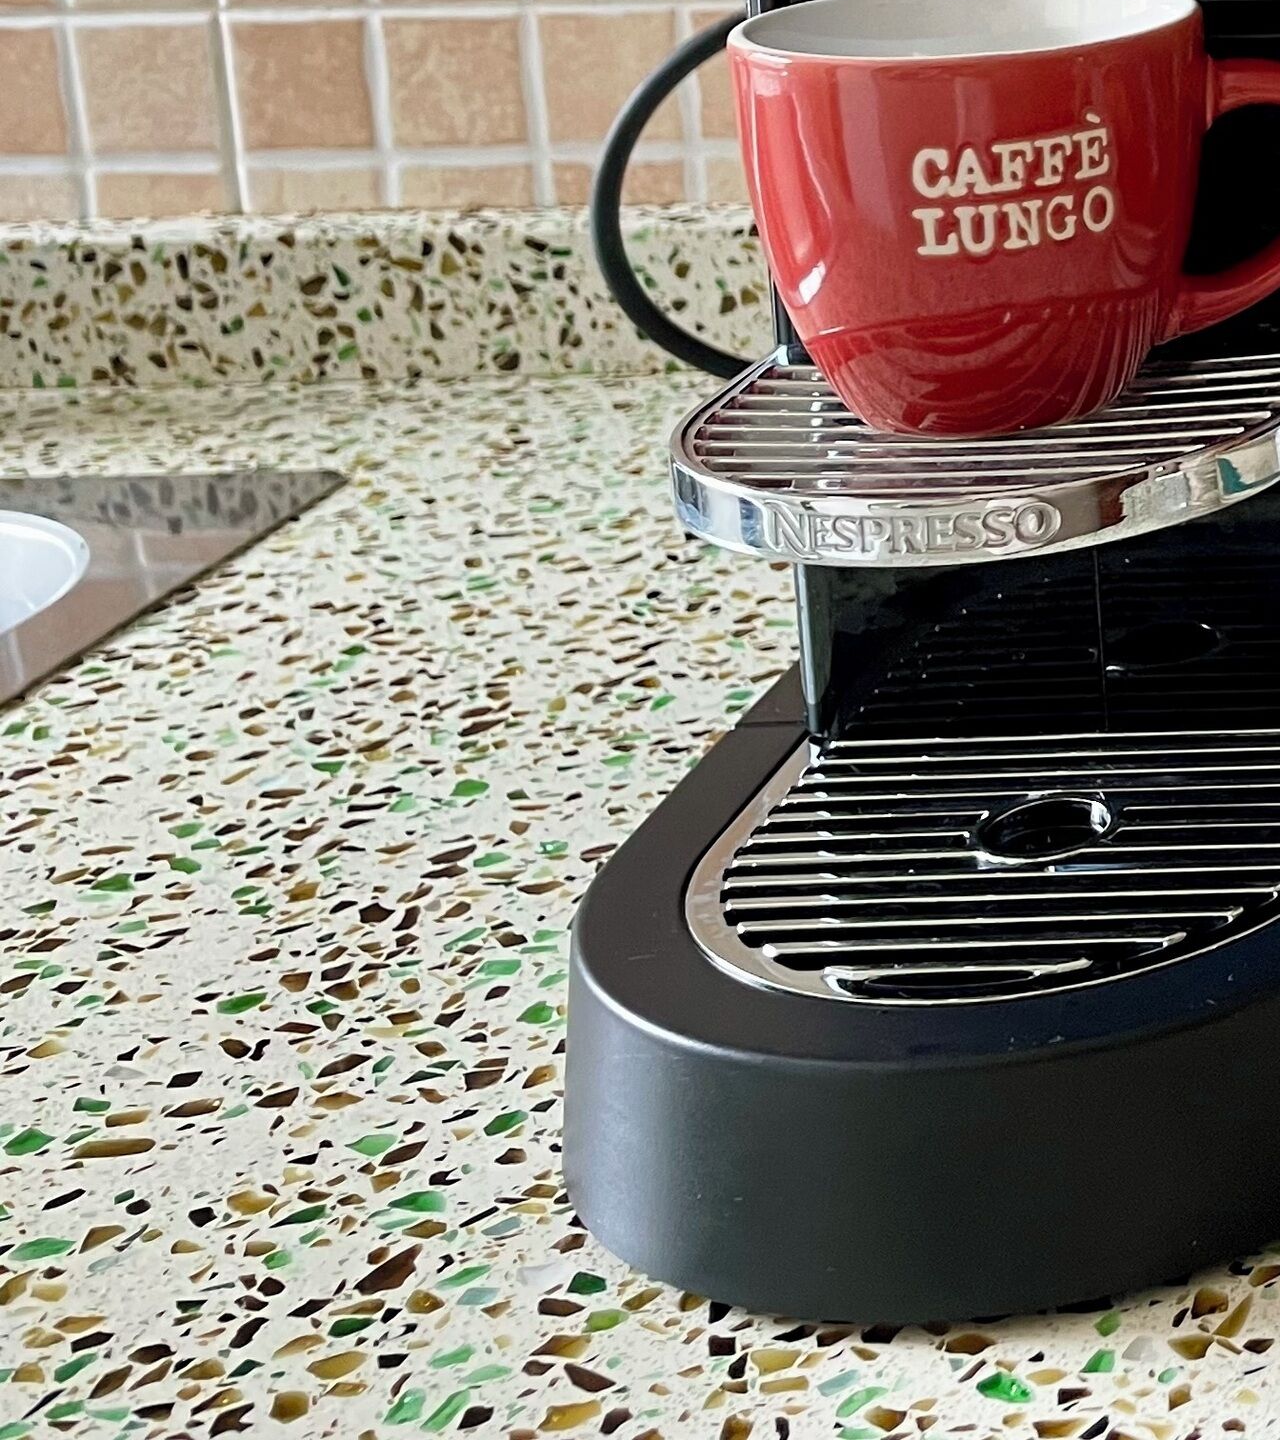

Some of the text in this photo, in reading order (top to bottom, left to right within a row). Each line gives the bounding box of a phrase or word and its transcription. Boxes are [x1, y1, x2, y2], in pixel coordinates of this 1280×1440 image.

[912, 112, 1111, 198] CAFFÈ
[912, 185, 1115, 256] LUNGO
[768, 498, 1063, 559] NESPRESSO
